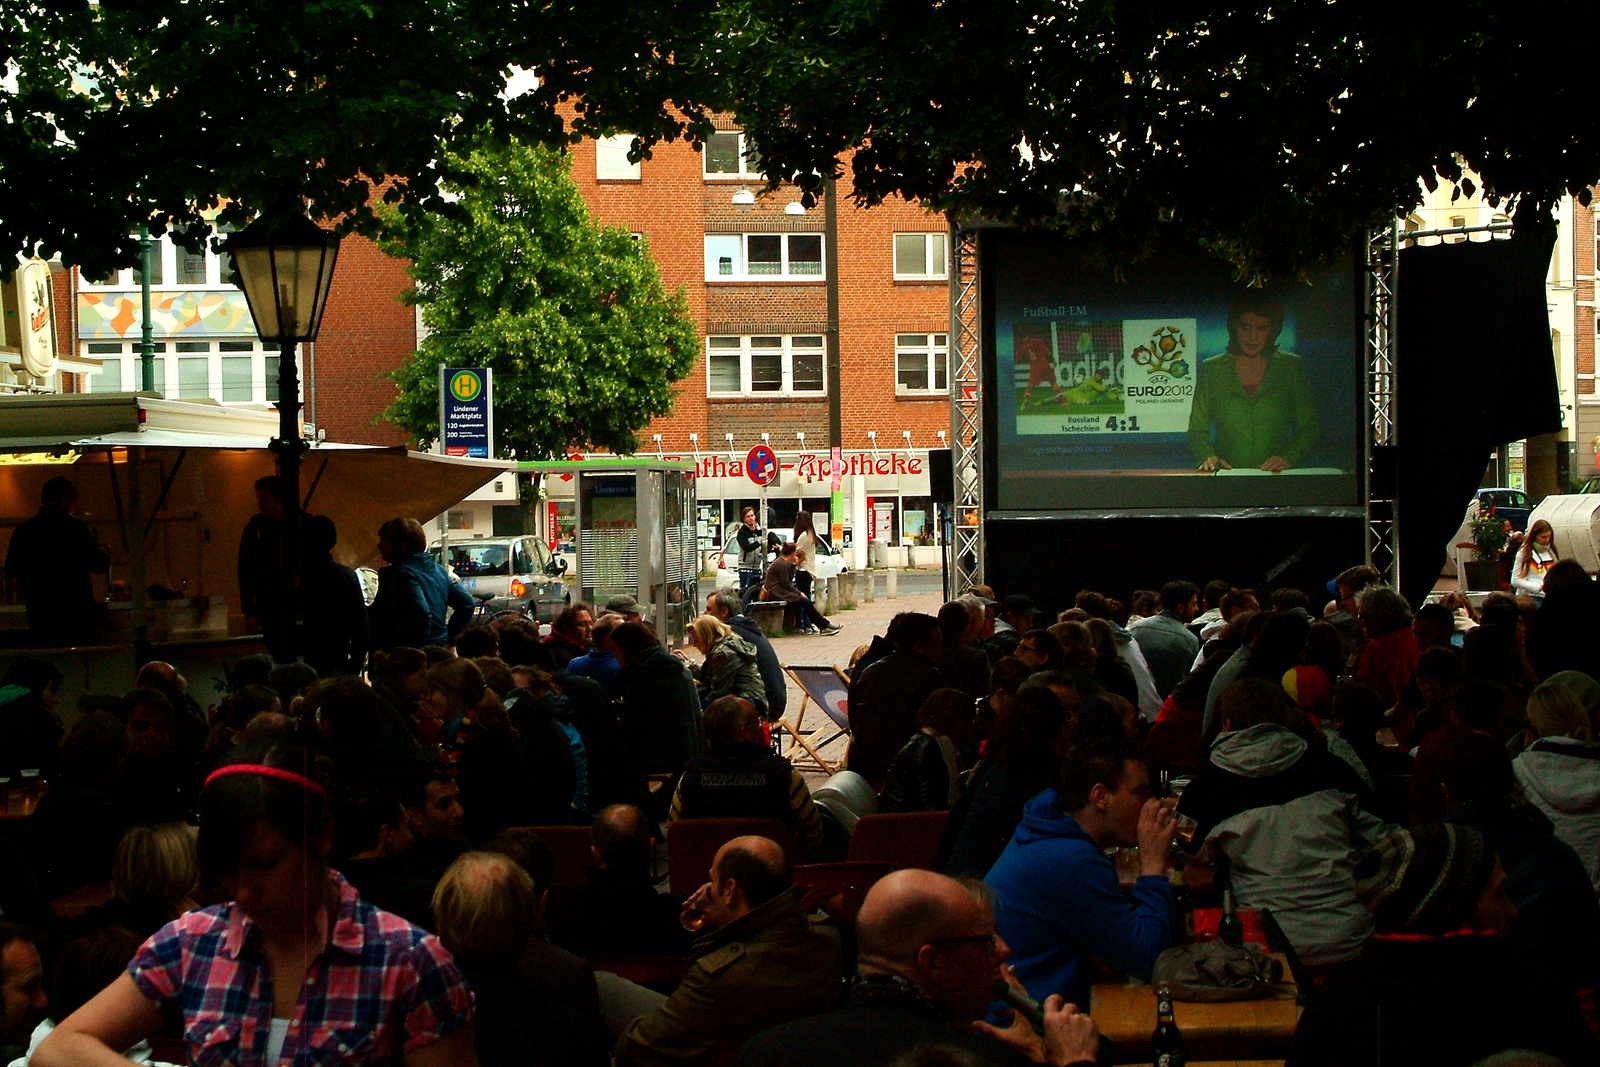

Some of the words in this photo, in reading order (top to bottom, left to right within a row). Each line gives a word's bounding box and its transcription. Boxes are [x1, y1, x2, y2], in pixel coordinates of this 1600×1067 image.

[1023, 305, 1087, 317] Fußball-EM
[459, 377, 472, 394] H
[450, 413, 482, 421] Marktplatz
[1105, 415, 1140, 431] 4:1
